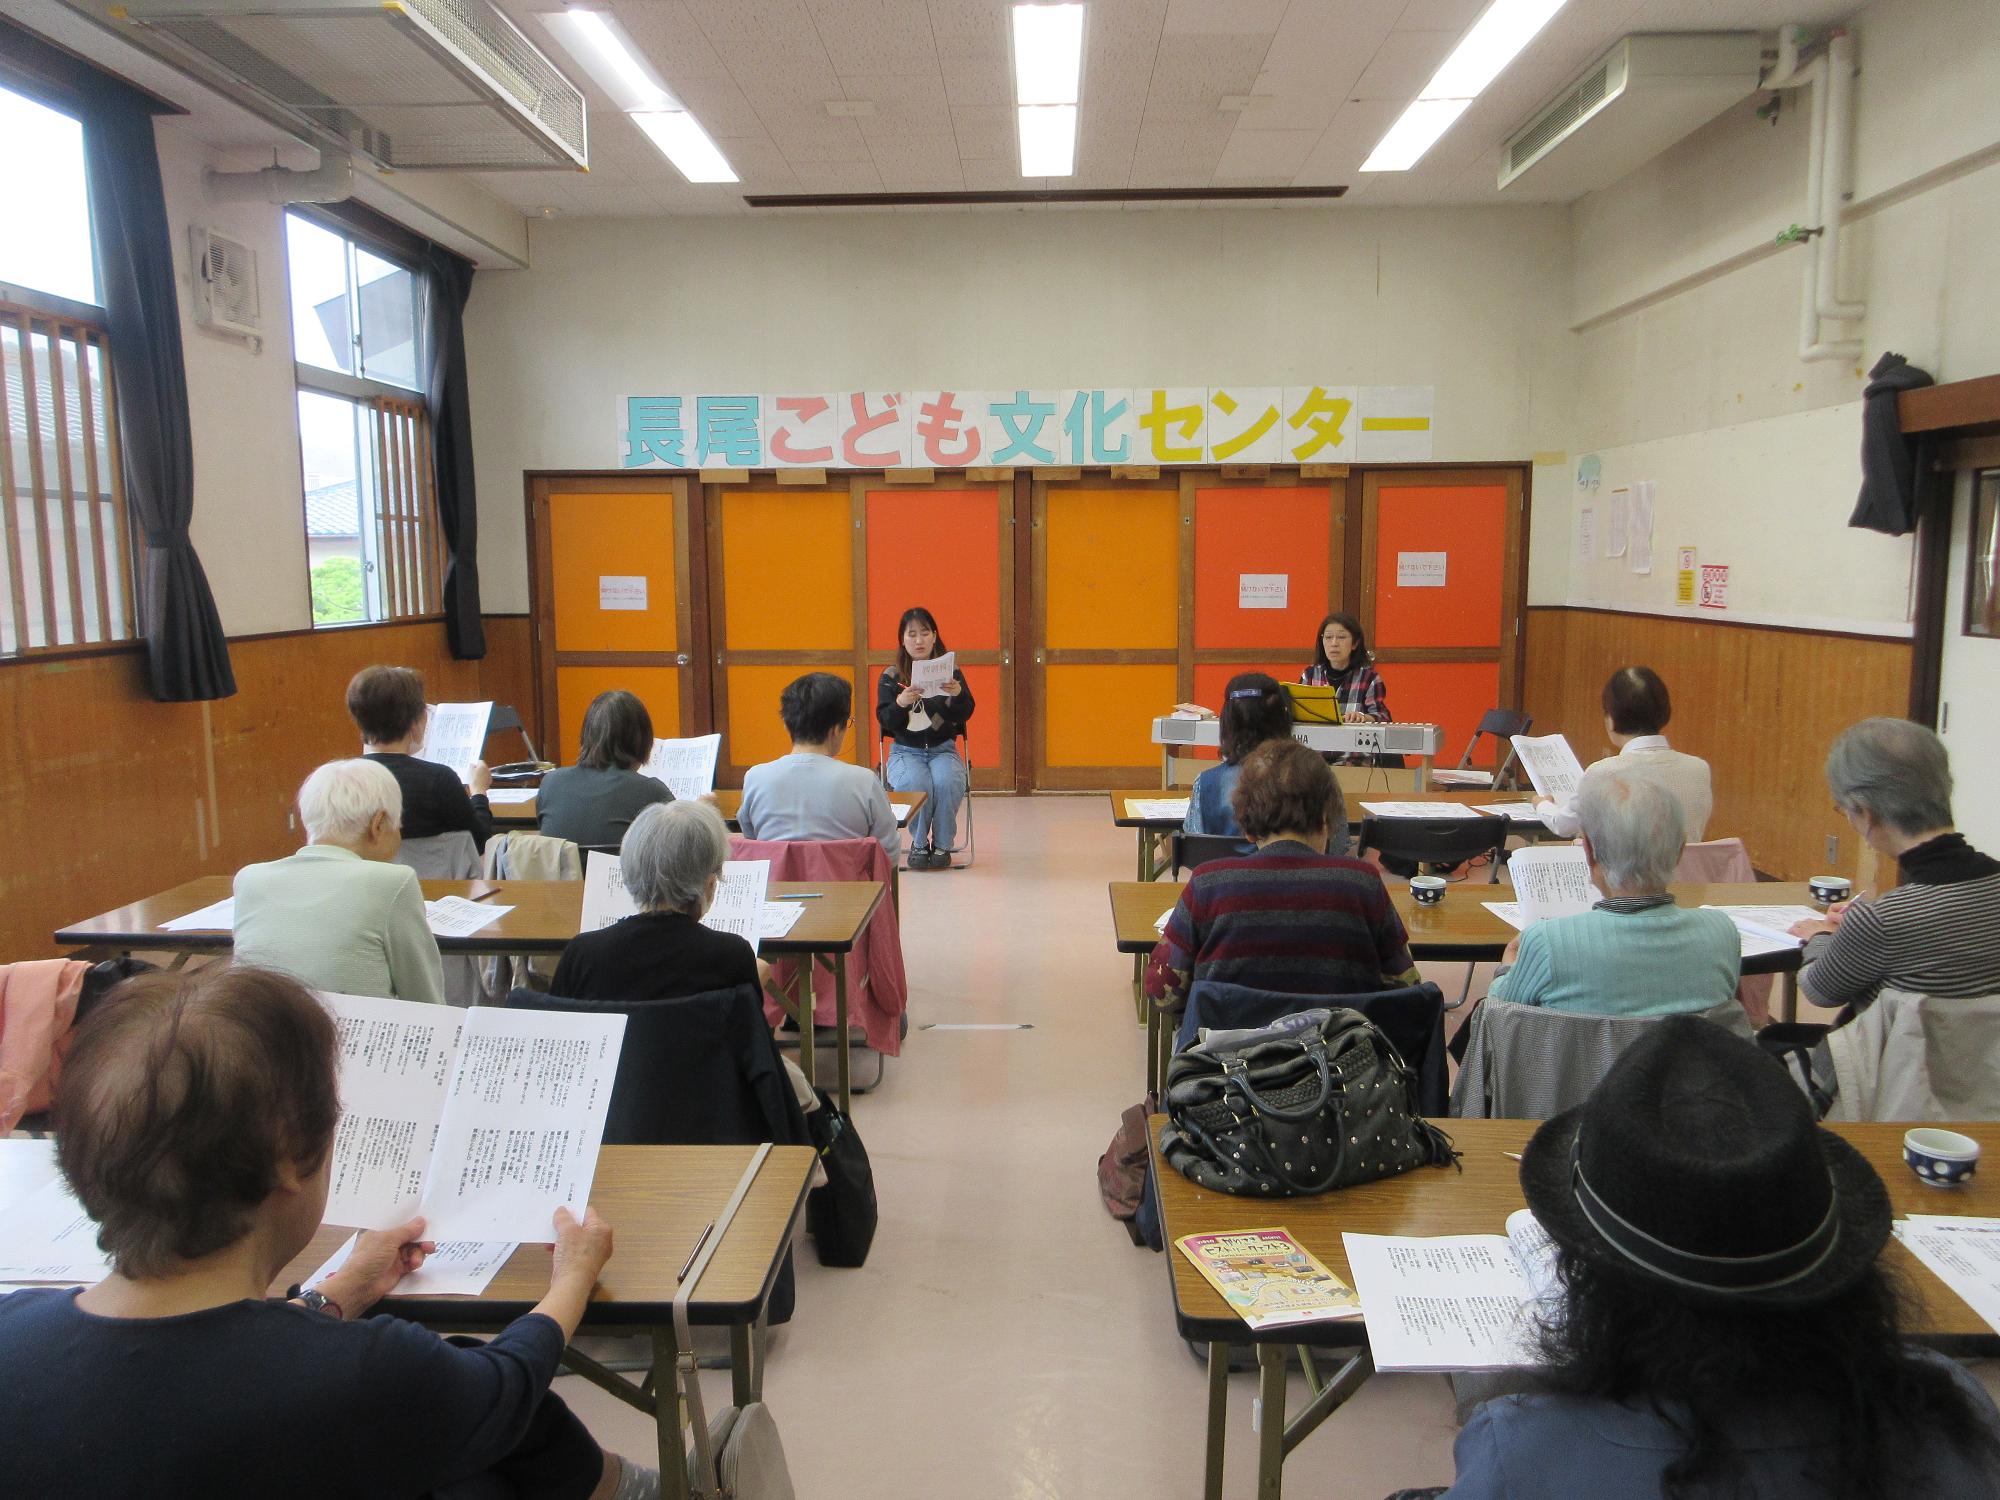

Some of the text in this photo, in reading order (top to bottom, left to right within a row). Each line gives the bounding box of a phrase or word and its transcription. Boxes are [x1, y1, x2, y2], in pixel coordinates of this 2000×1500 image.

[624, 386, 1430, 467] 長尾こども文化センター
